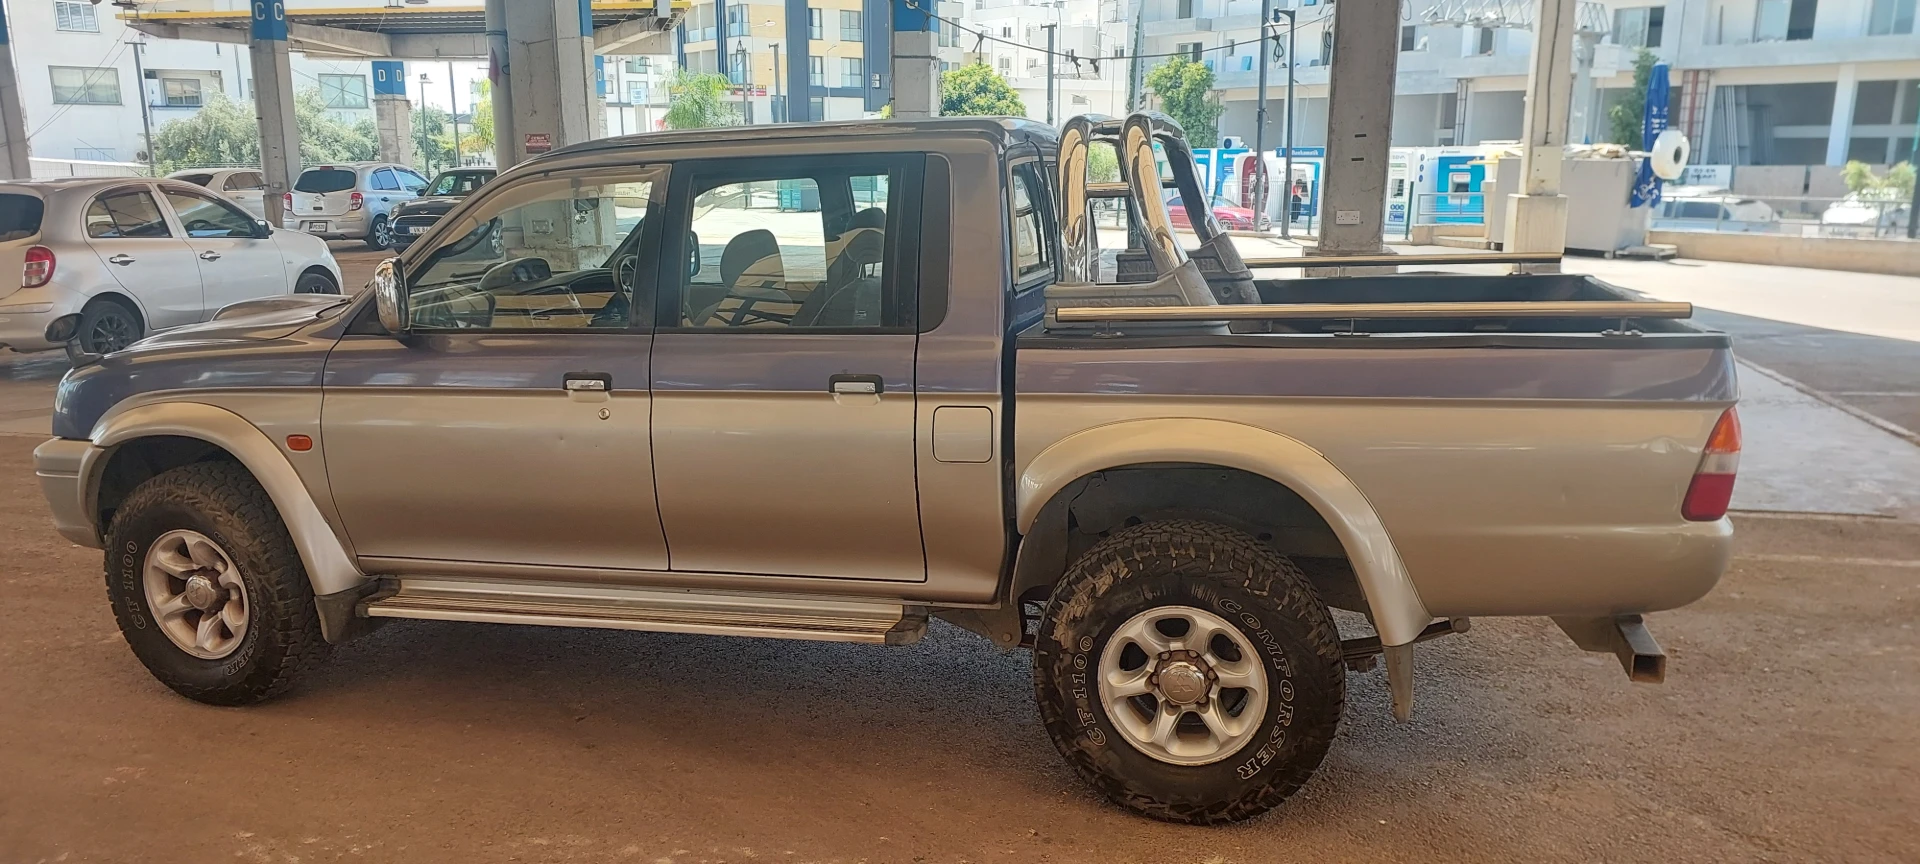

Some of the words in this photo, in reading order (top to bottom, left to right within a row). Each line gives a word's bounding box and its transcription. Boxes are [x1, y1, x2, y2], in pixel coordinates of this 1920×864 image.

[255, 2, 265, 20] C
[274, 2, 283, 20] C
[378, 69, 386, 81] D
[396, 69, 402, 81] D
[122, 541, 137, 590] 1100
[1072, 635, 1093, 698] 1100
[1218, 598, 1295, 780] COMFORSER
[1077, 708, 1107, 746] CF
